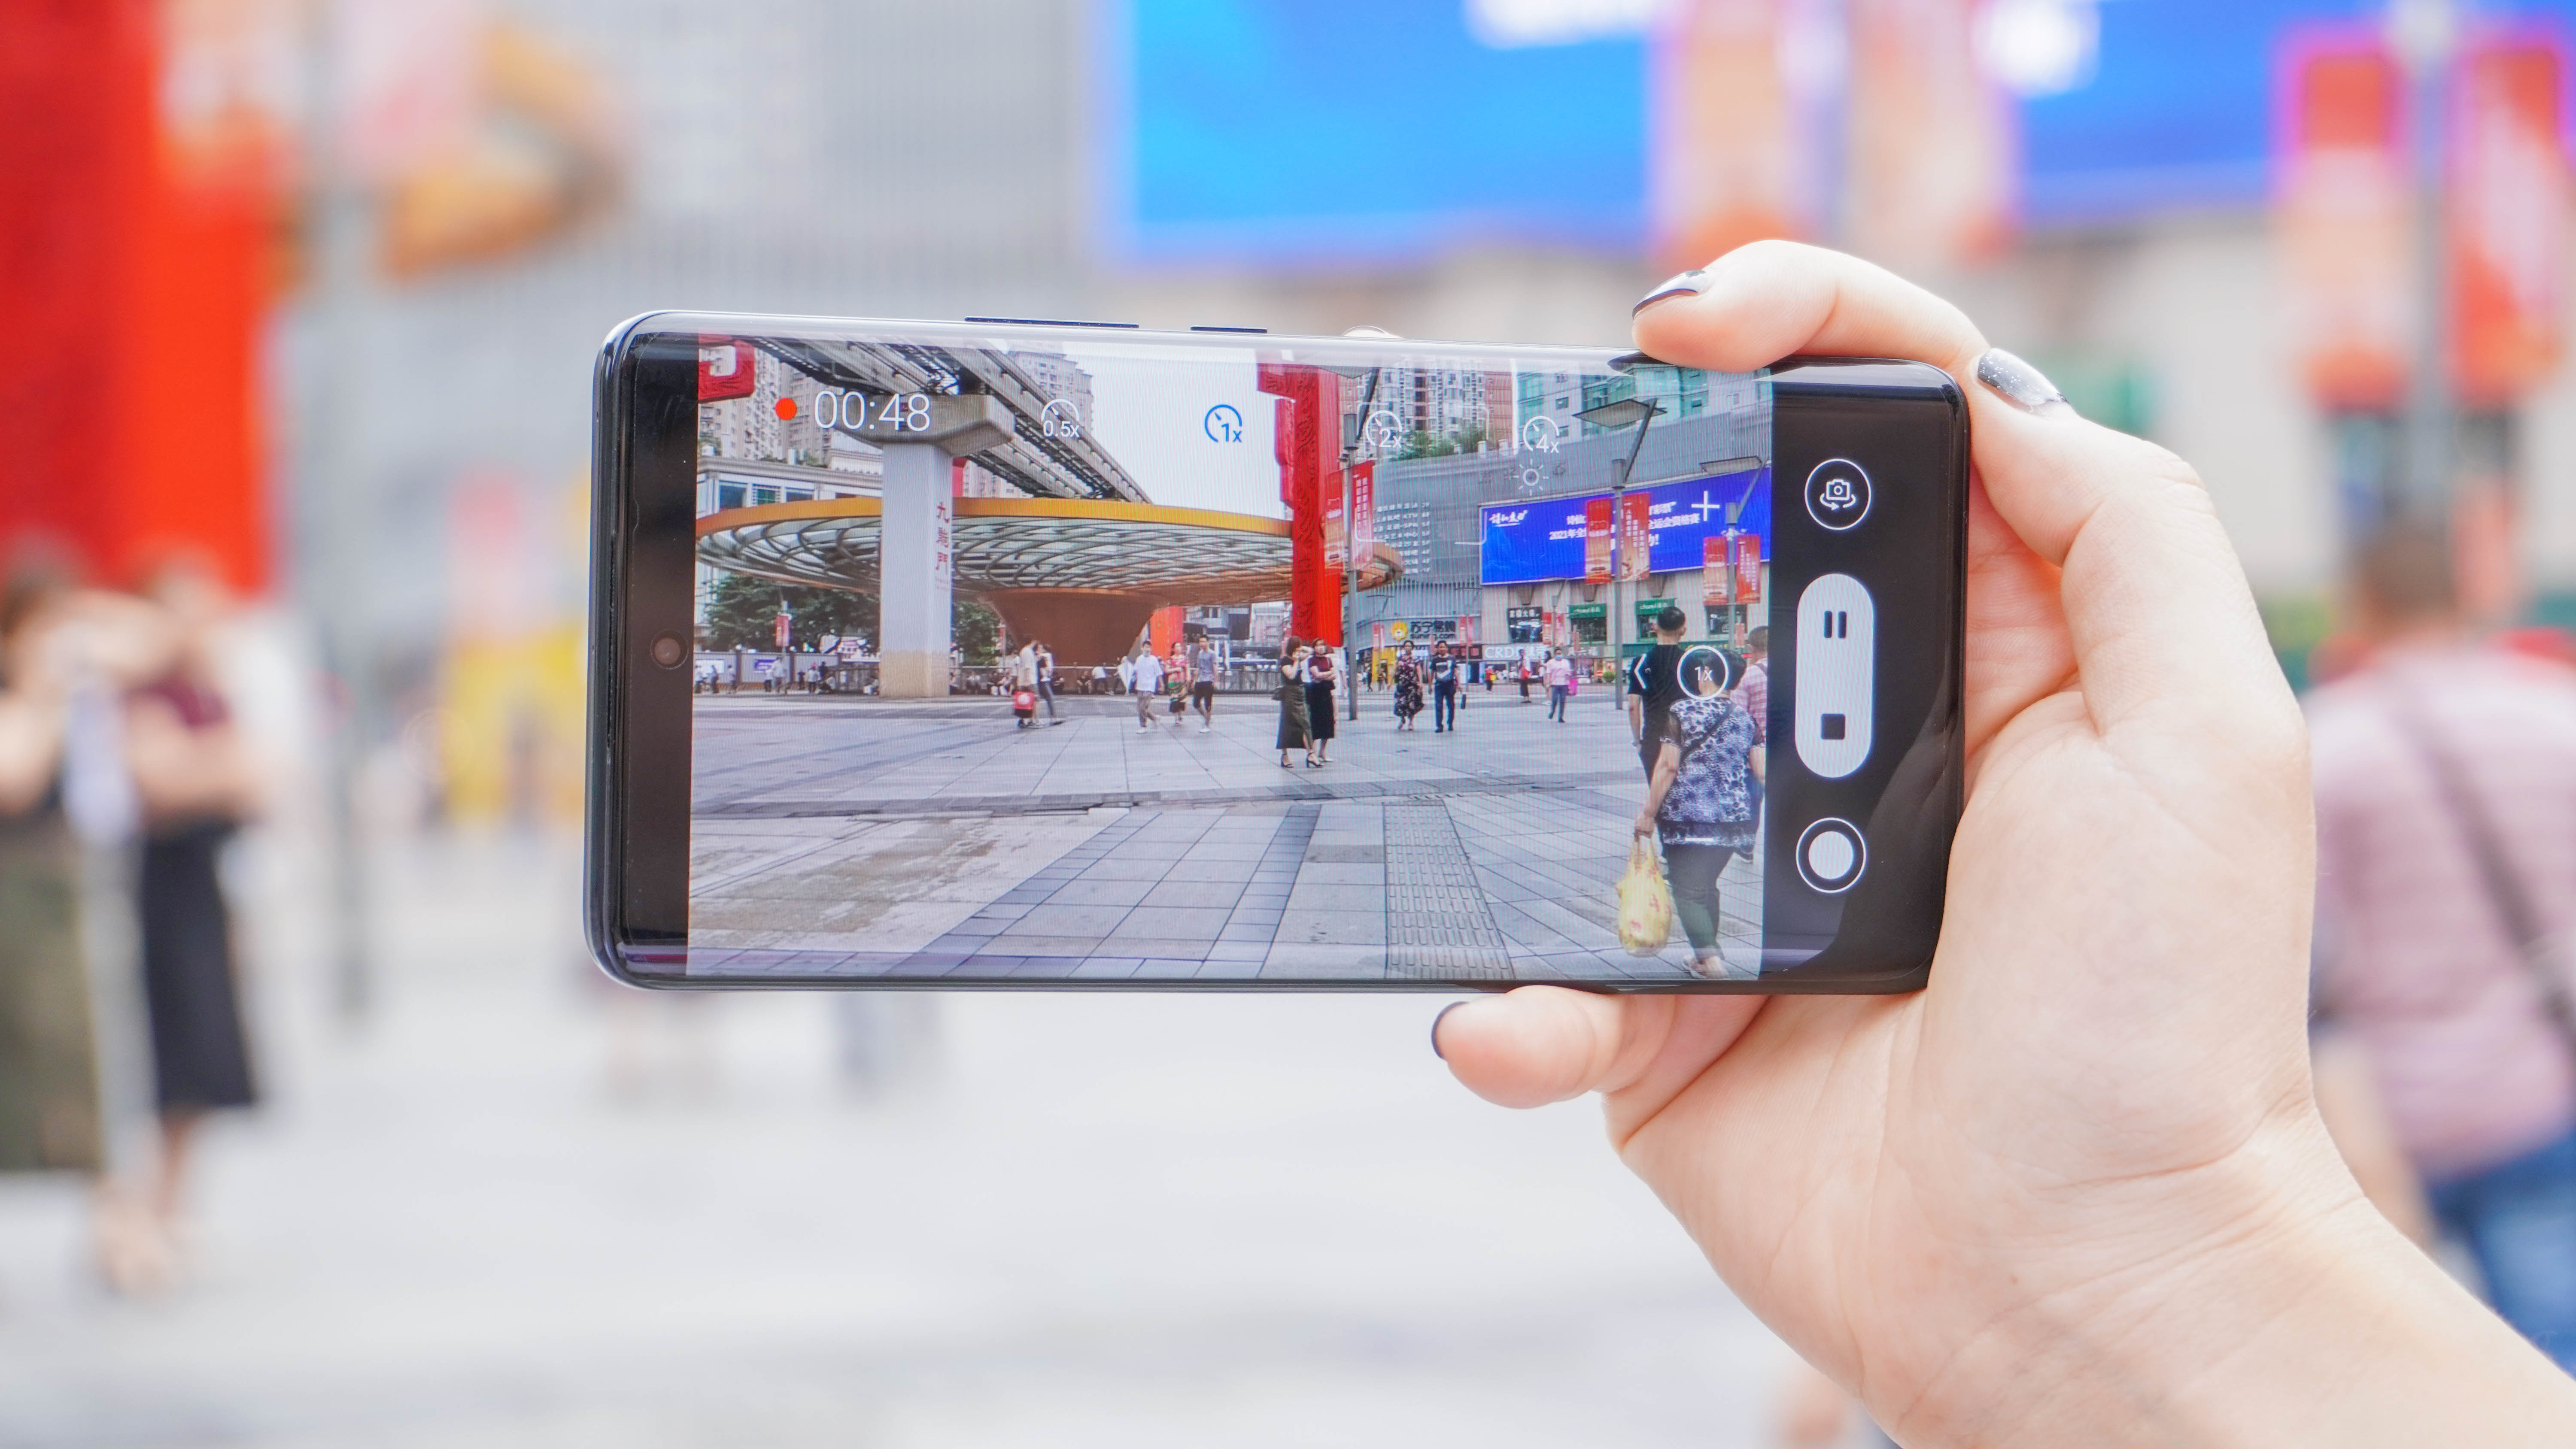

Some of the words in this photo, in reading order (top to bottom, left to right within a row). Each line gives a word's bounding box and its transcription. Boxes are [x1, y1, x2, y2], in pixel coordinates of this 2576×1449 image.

[814, 390, 931, 431] 00:48
[1043, 421, 1080, 438] 0.5x
[1221, 423, 1242, 443] 1x
[1379, 428, 1402, 448] 2x
[1536, 434, 1559, 454] 4x
[1549, 527, 1587, 540] 2021年全
[1695, 666, 1713, 681] 1x
